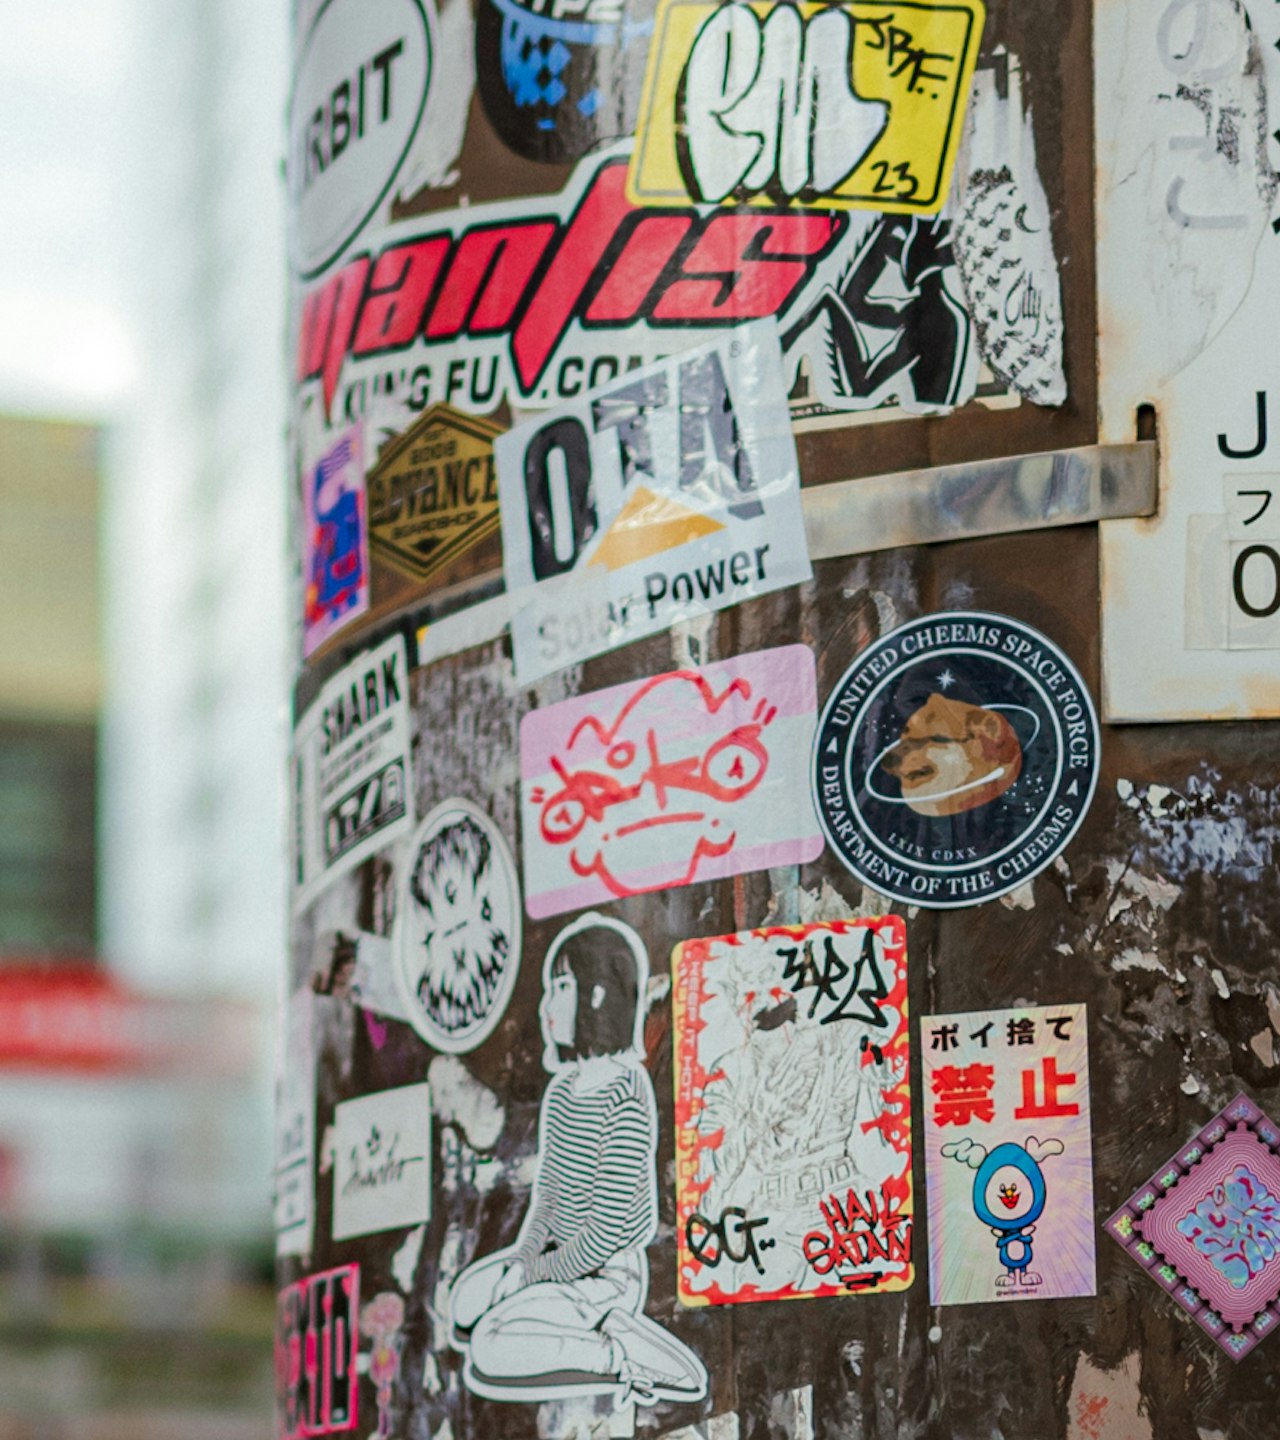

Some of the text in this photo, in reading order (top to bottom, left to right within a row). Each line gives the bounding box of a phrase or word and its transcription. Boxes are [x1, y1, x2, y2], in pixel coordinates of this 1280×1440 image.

[870, 160, 919, 199] 23
[445, 354, 500, 405] FU
[644, 544, 771, 620] Power
[831, 623, 1090, 770] UNITED CHEEMS SPACE FORCE
[822, 764, 1074, 896] DEPARTMENT OF THE CHEEMS
[931, 846, 978, 861] CDXX
[930, 1015, 1075, 1052] ポイ捨て
[930, 1056, 1080, 1128] 禁止
[802, 1222, 914, 1276] SATAN
